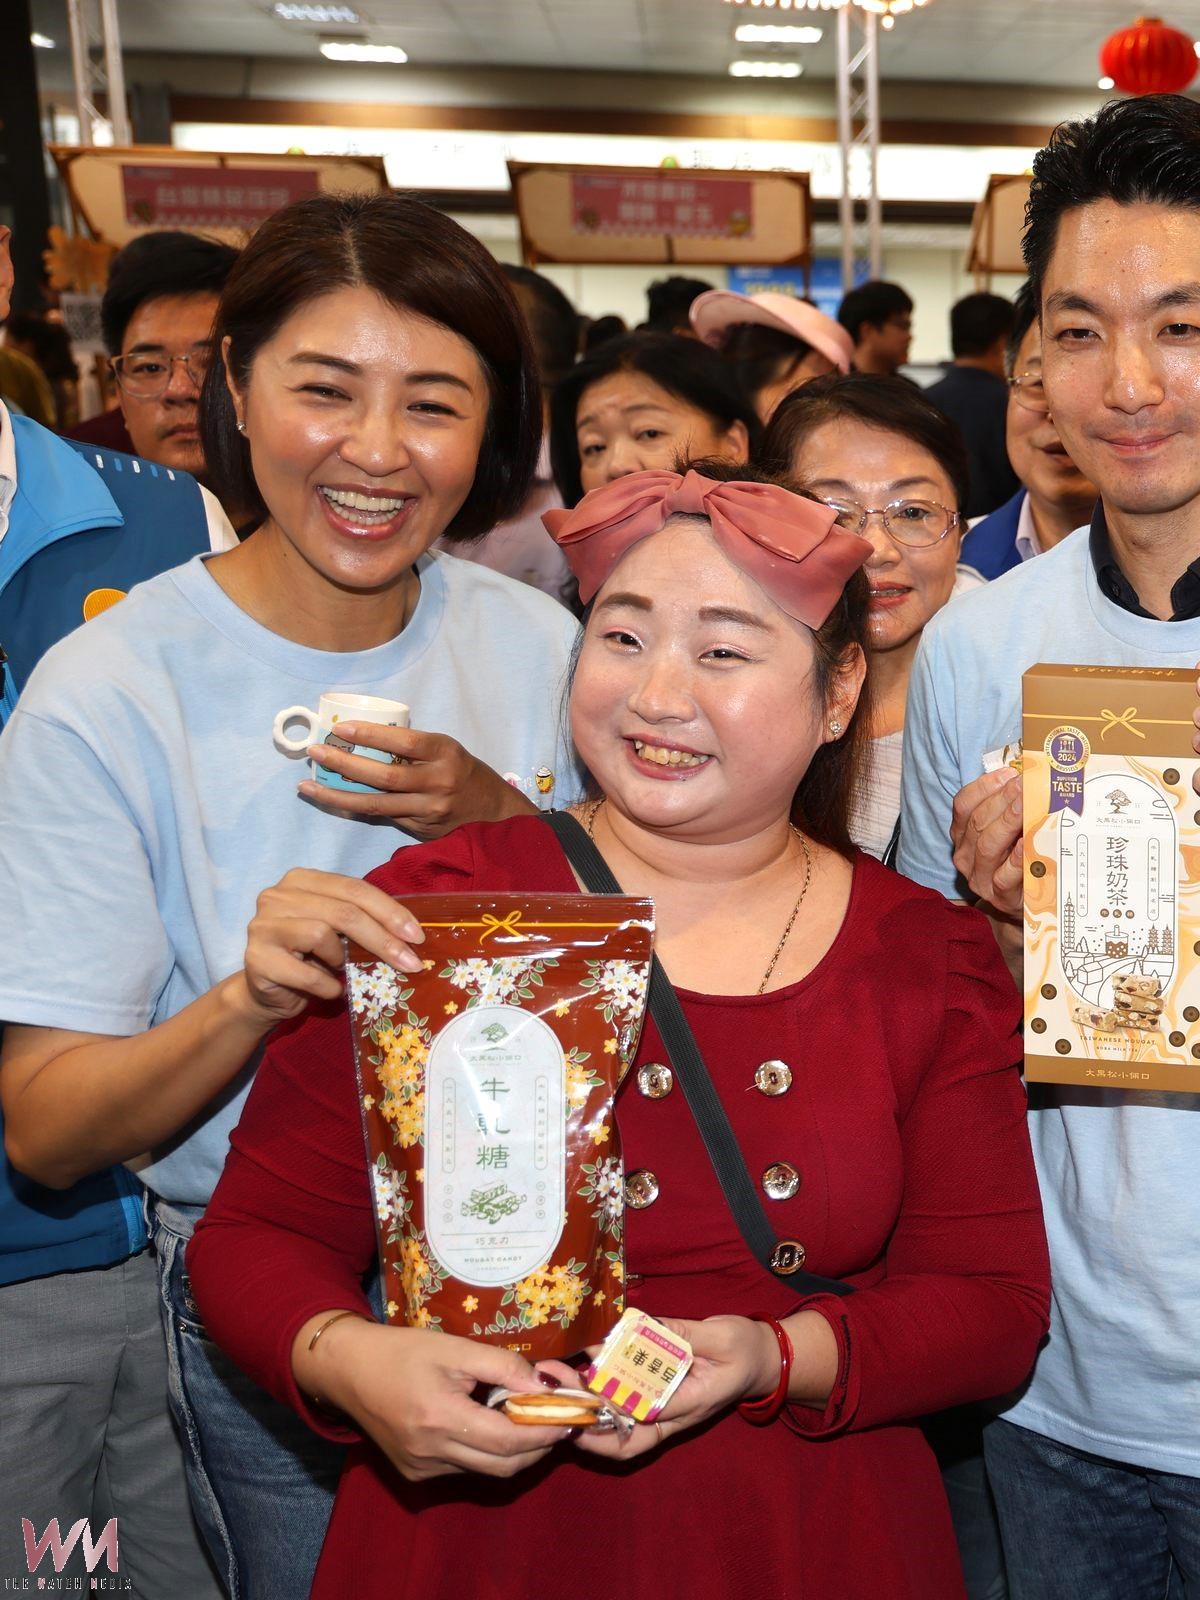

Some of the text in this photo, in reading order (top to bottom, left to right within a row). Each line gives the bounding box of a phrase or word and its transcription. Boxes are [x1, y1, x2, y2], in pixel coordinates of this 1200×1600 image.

[1058, 753, 1077, 762] 2024
[1056, 764, 1079, 772] BRUSSELS
[1052, 781, 1083, 793] TASTE
[1106, 836, 1129, 906] 珍珠奶茶
[1080, 1035, 1121, 1043] TAIWANESE
[475, 1237, 510, 1245] 巧克力
[632, 1347, 678, 1384] 百香果
